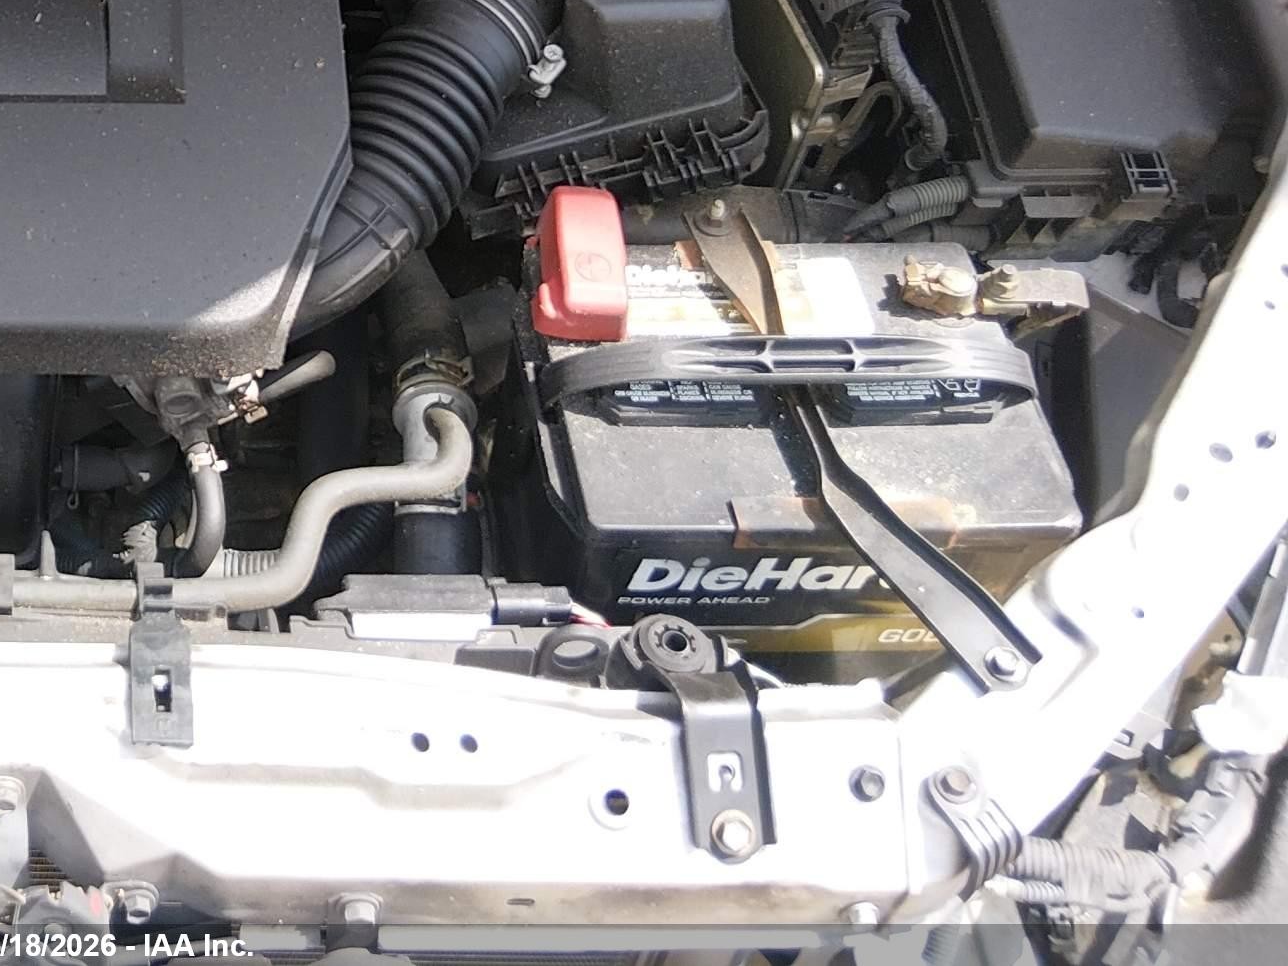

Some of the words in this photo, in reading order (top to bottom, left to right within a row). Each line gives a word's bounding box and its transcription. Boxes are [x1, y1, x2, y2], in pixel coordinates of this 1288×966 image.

[627, 557, 891, 590] DieHar
[617, 596, 691, 604] POWER
[697, 596, 770, 604] AHEAD
[878, 628, 939, 643] GOL
